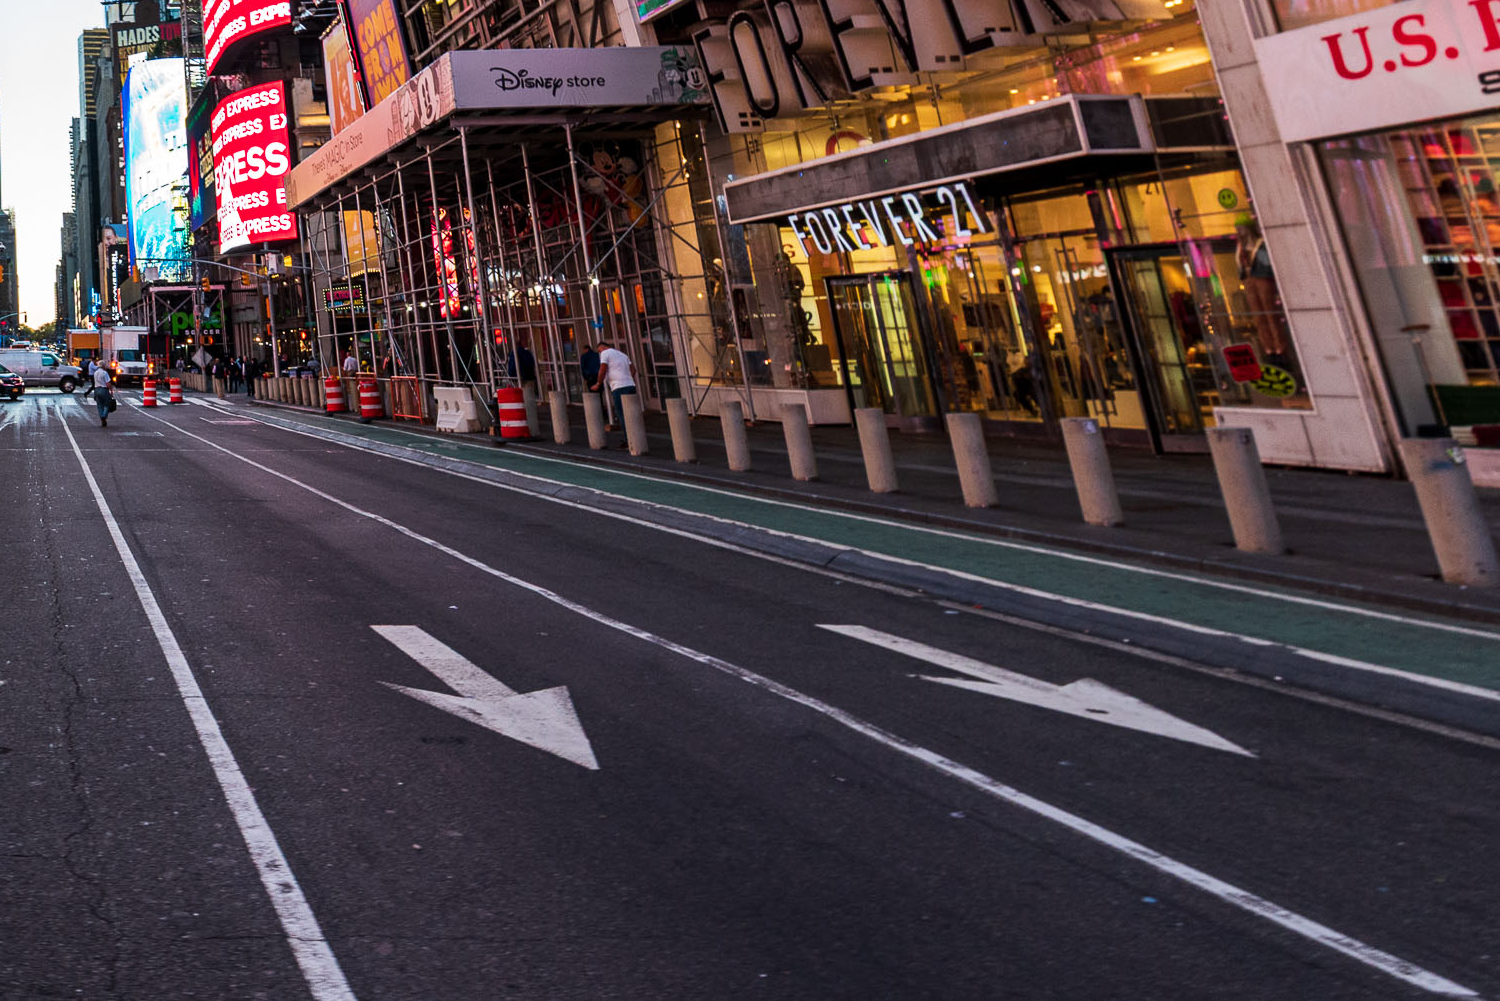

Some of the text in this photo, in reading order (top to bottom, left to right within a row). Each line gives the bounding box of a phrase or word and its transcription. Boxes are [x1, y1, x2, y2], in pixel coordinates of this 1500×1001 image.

[117, 23, 181, 47] HADESTOW
[1321, 12, 1460, 81] U.S.
[362, 29, 404, 87] FROM
[566, 74, 606, 88] store
[226, 88, 280, 118] EXPRESS
[222, 118, 263, 145] EXPRESS
[214, 142, 289, 197] EXPRESS
[236, 214, 291, 237] EXPRESS
[787, 182, 987, 258] FOREVER 21
